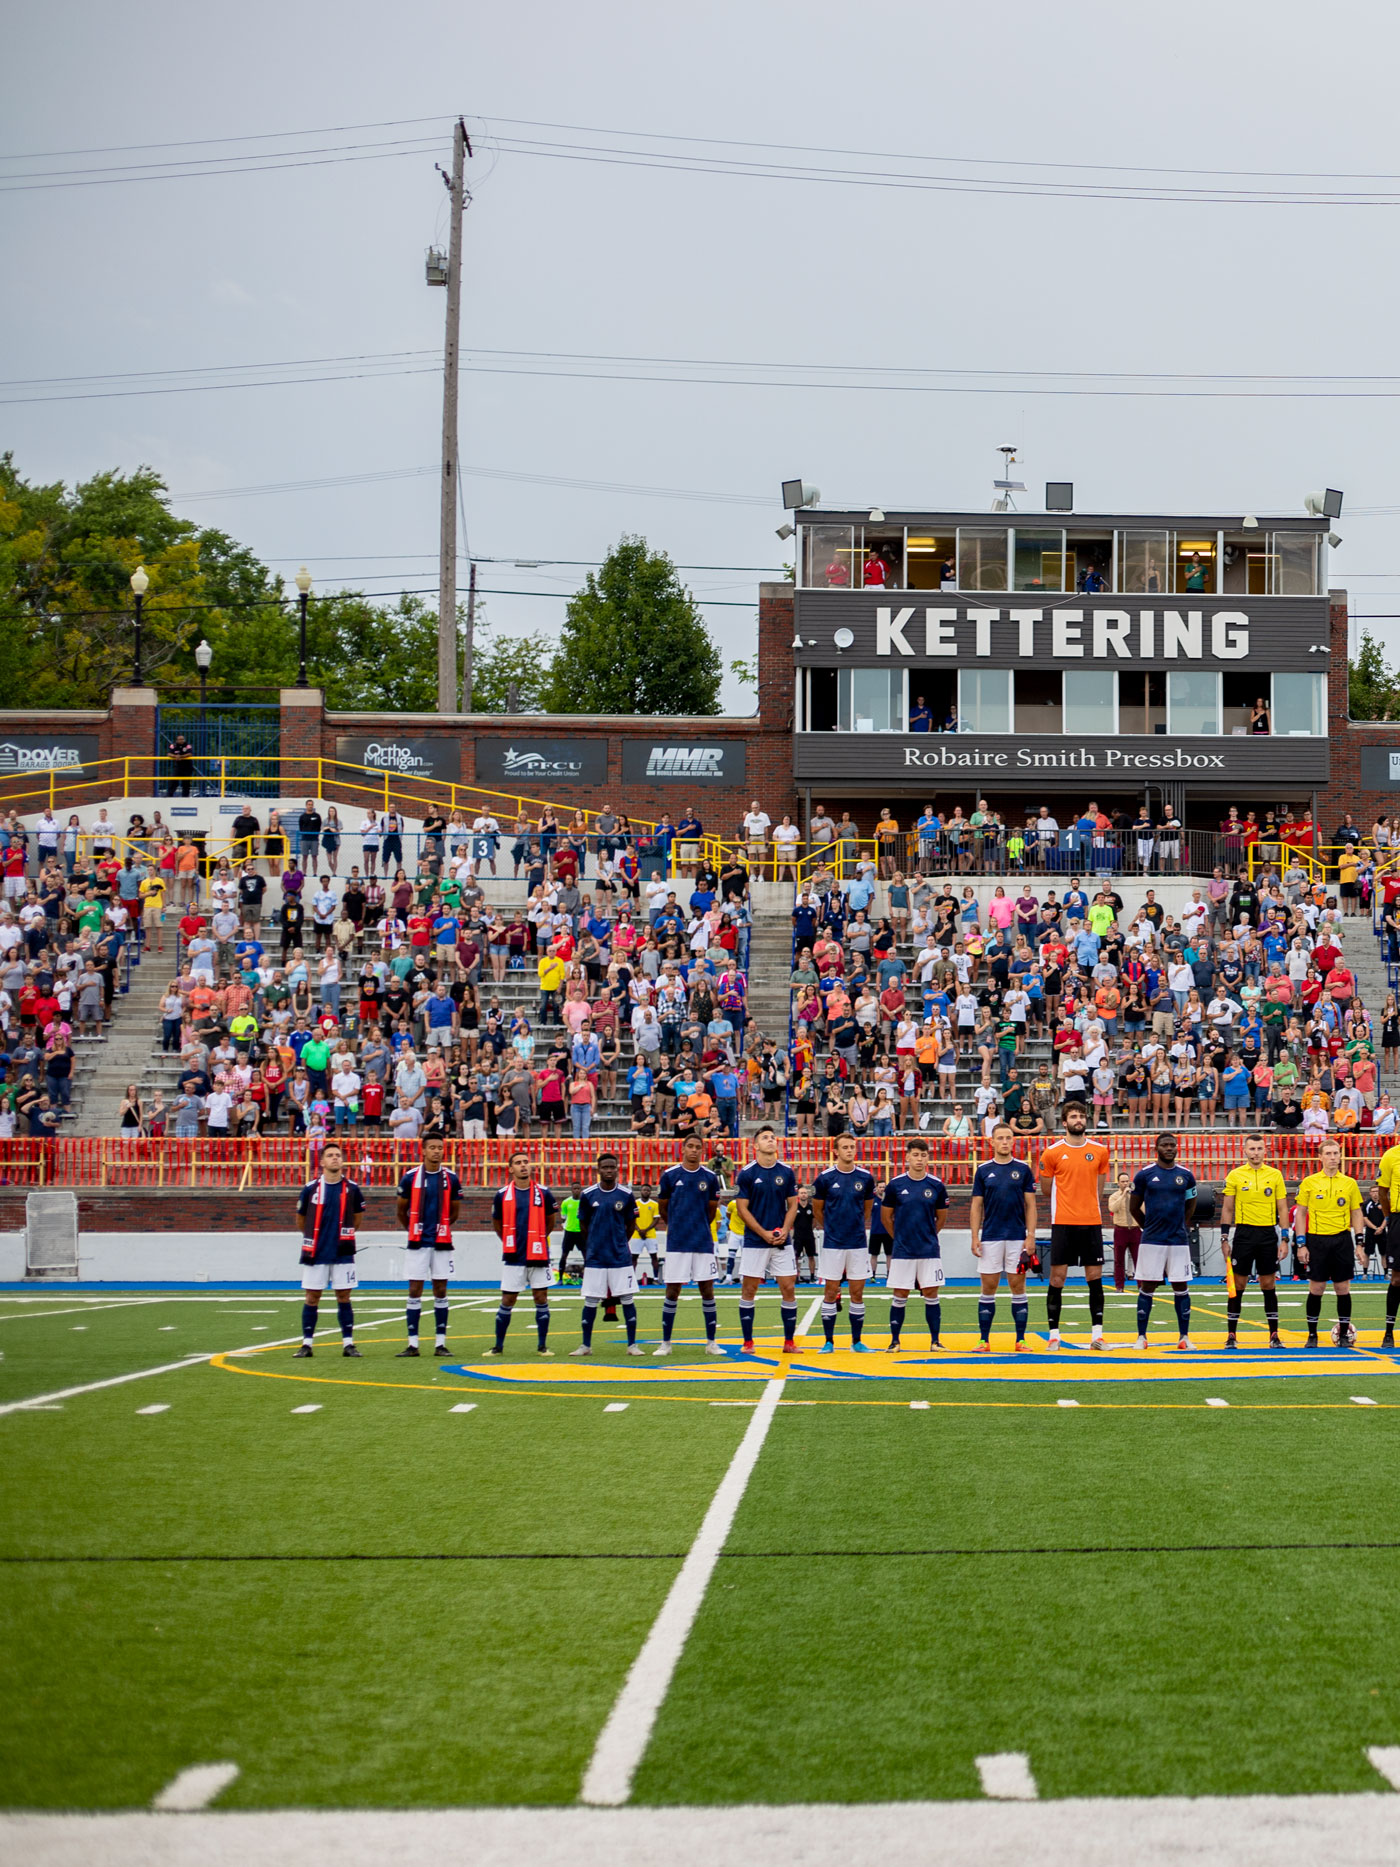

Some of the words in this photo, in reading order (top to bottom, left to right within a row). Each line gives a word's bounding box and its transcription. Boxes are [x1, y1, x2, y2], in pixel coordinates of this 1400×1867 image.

[876, 607, 1249, 659] KETTERING
[17, 746, 80, 761] DOVER
[366, 743, 411, 757] Ortho
[646, 747, 724, 771] MMR
[903, 747, 1009, 766] Robaire
[1016, 748, 1097, 767] Smith
[1104, 748, 1226, 768] Pressbox
[527, 762, 583, 770] PFCU
[1065, 832, 1073, 849] 1
[478, 840, 488, 857] 3
[449, 1260, 455, 1273] 5
[346, 1271, 356, 1284] 14
[545, 1268, 552, 1281] 8
[627, 1275, 633, 1288] 7
[934, 1268, 944, 1282] 10
